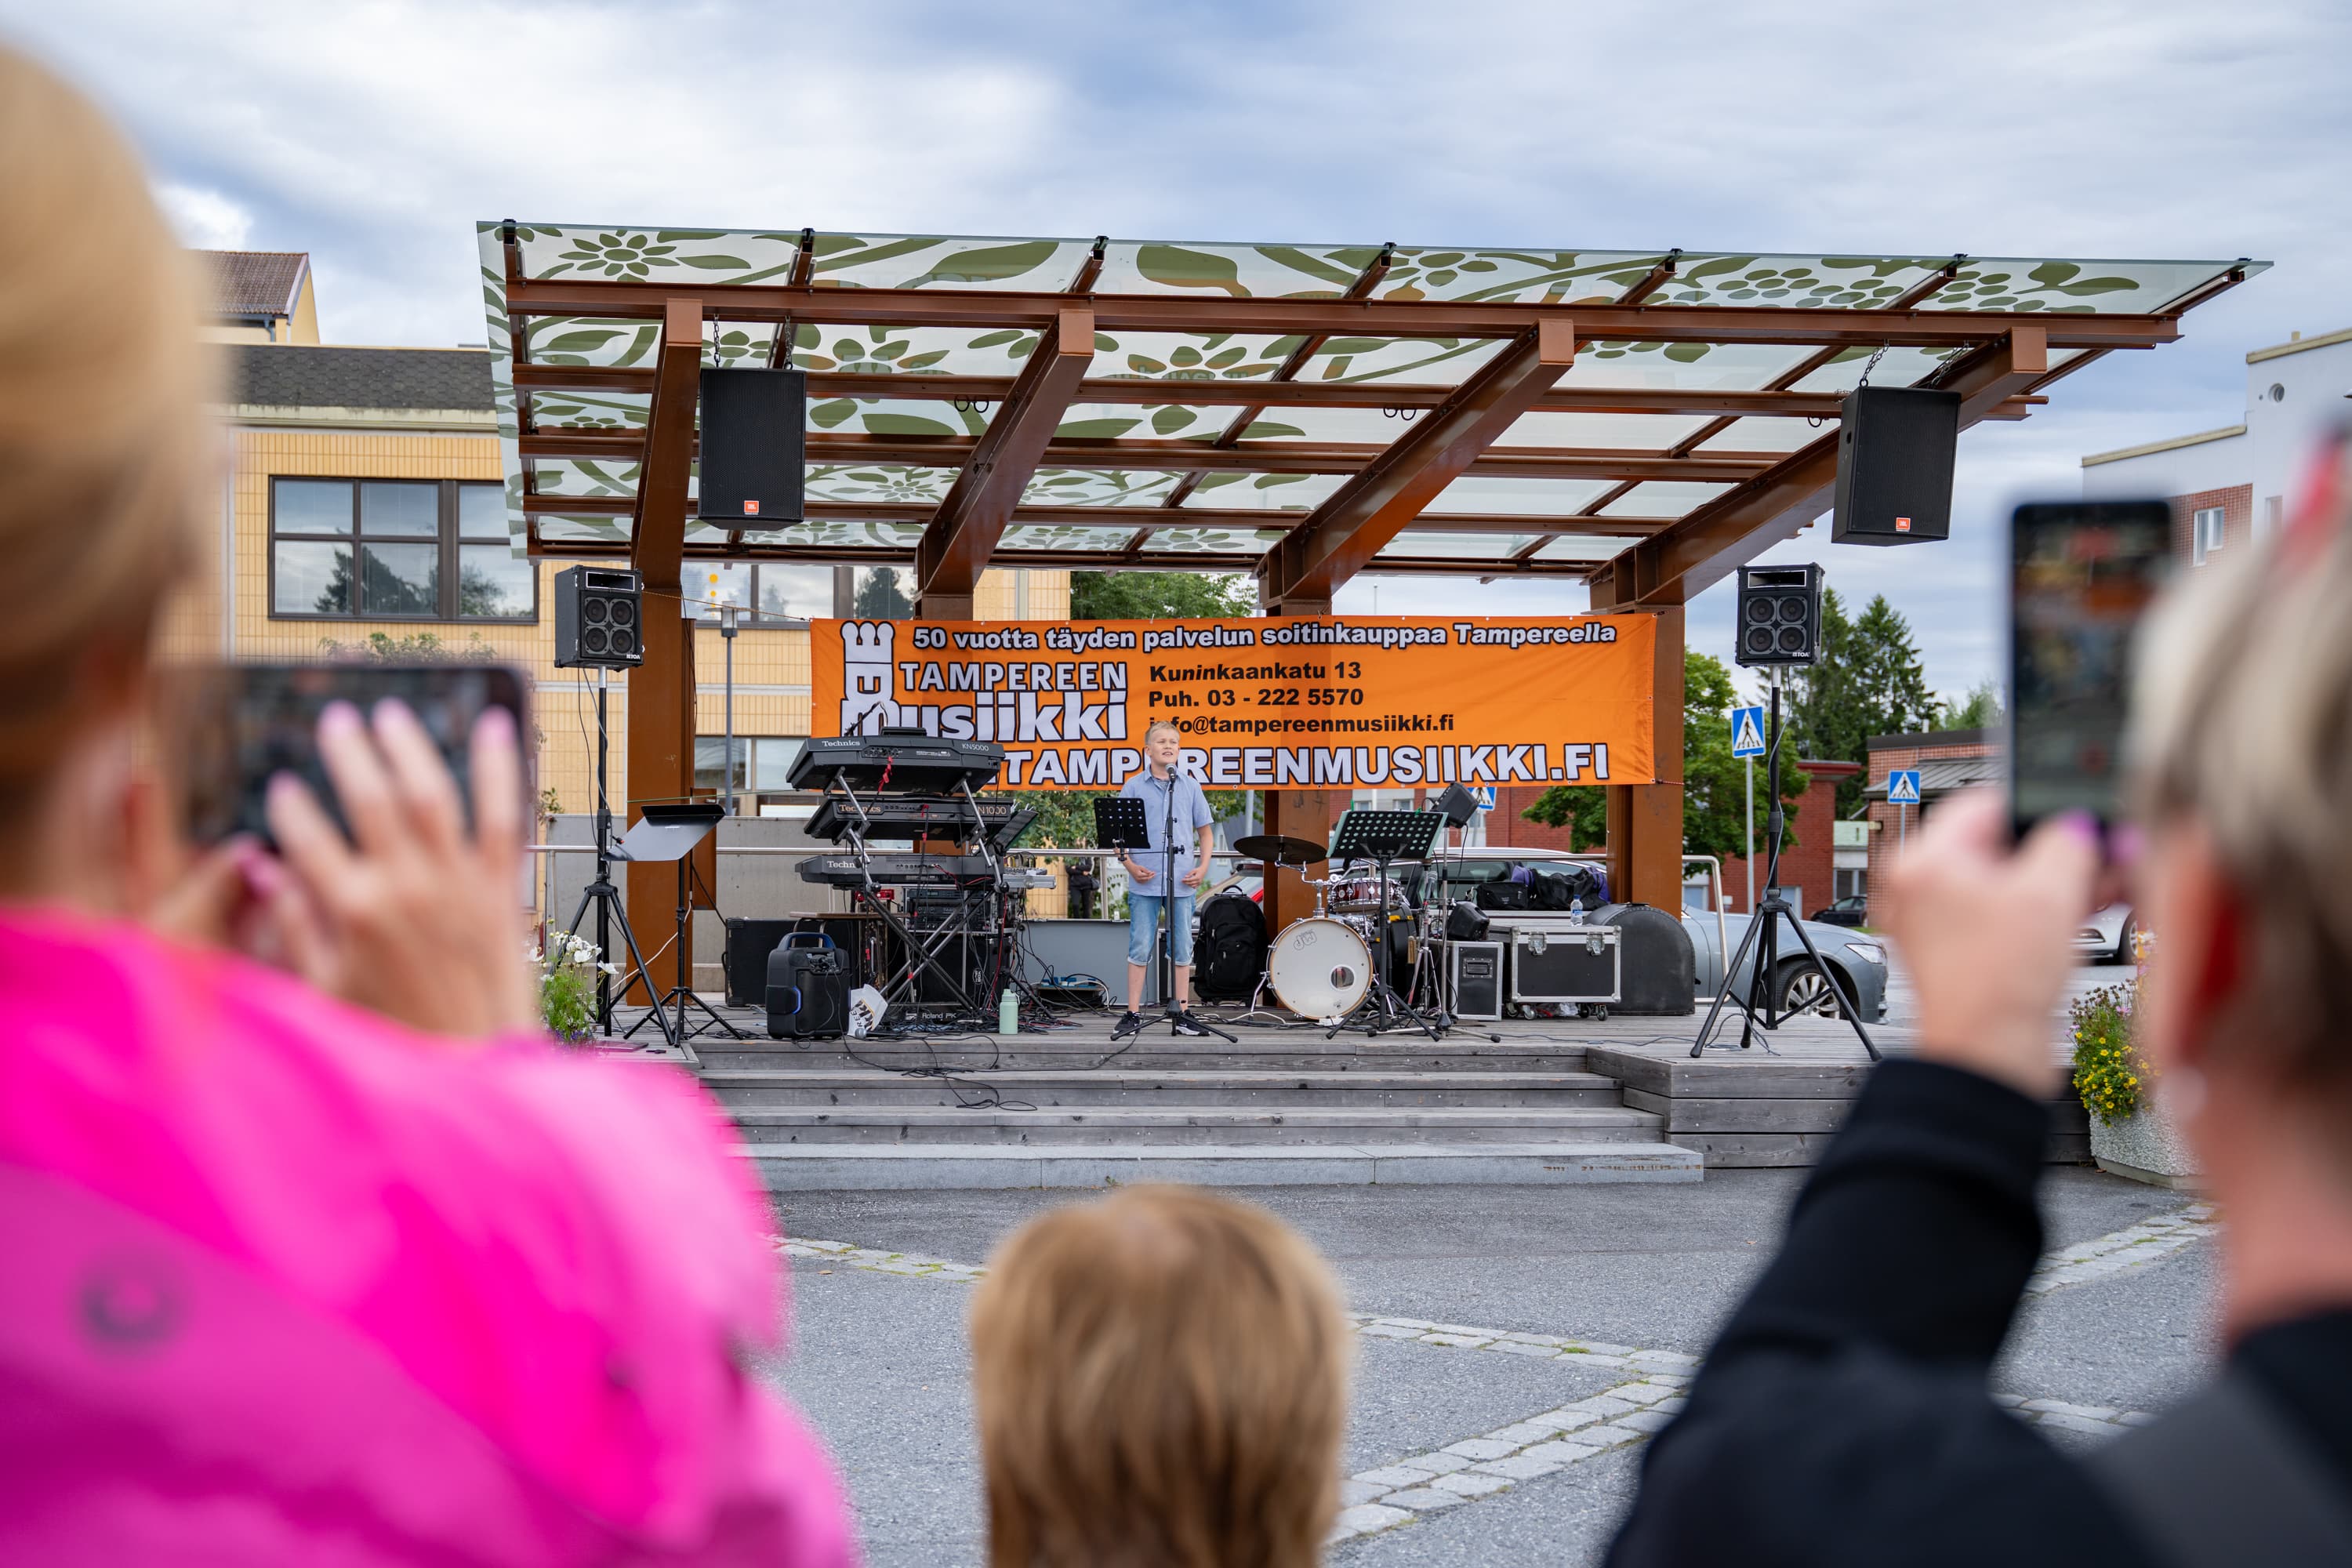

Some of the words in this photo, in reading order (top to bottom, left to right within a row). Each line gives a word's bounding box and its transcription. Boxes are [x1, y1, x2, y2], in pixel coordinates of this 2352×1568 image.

[913, 626, 947, 649] 50
[953, 628, 1040, 650] vuotta
[1044, 627, 1136, 654] täyden
[1142, 626, 1254, 653] palvelun
[1261, 622, 1447, 650] soitinkauppaa
[1454, 622, 1617, 649] Tampereella
[898, 661, 1128, 692] TAMPEREEN
[1150, 662, 1326, 683] Kuninkaankatu
[1334, 661, 1362, 680] 13
[1149, 690, 1199, 707] Puh.
[1208, 689, 1236, 706] 03
[1258, 688, 1301, 706] 222
[1308, 688, 1363, 706] 5570
[840, 690, 1127, 742] musiikki
[962, 743, 989, 752] KN5000
[986, 742, 1610, 786] TAMPREENMUSIIKKI.FI
[978, 806, 1007, 815] N1000
